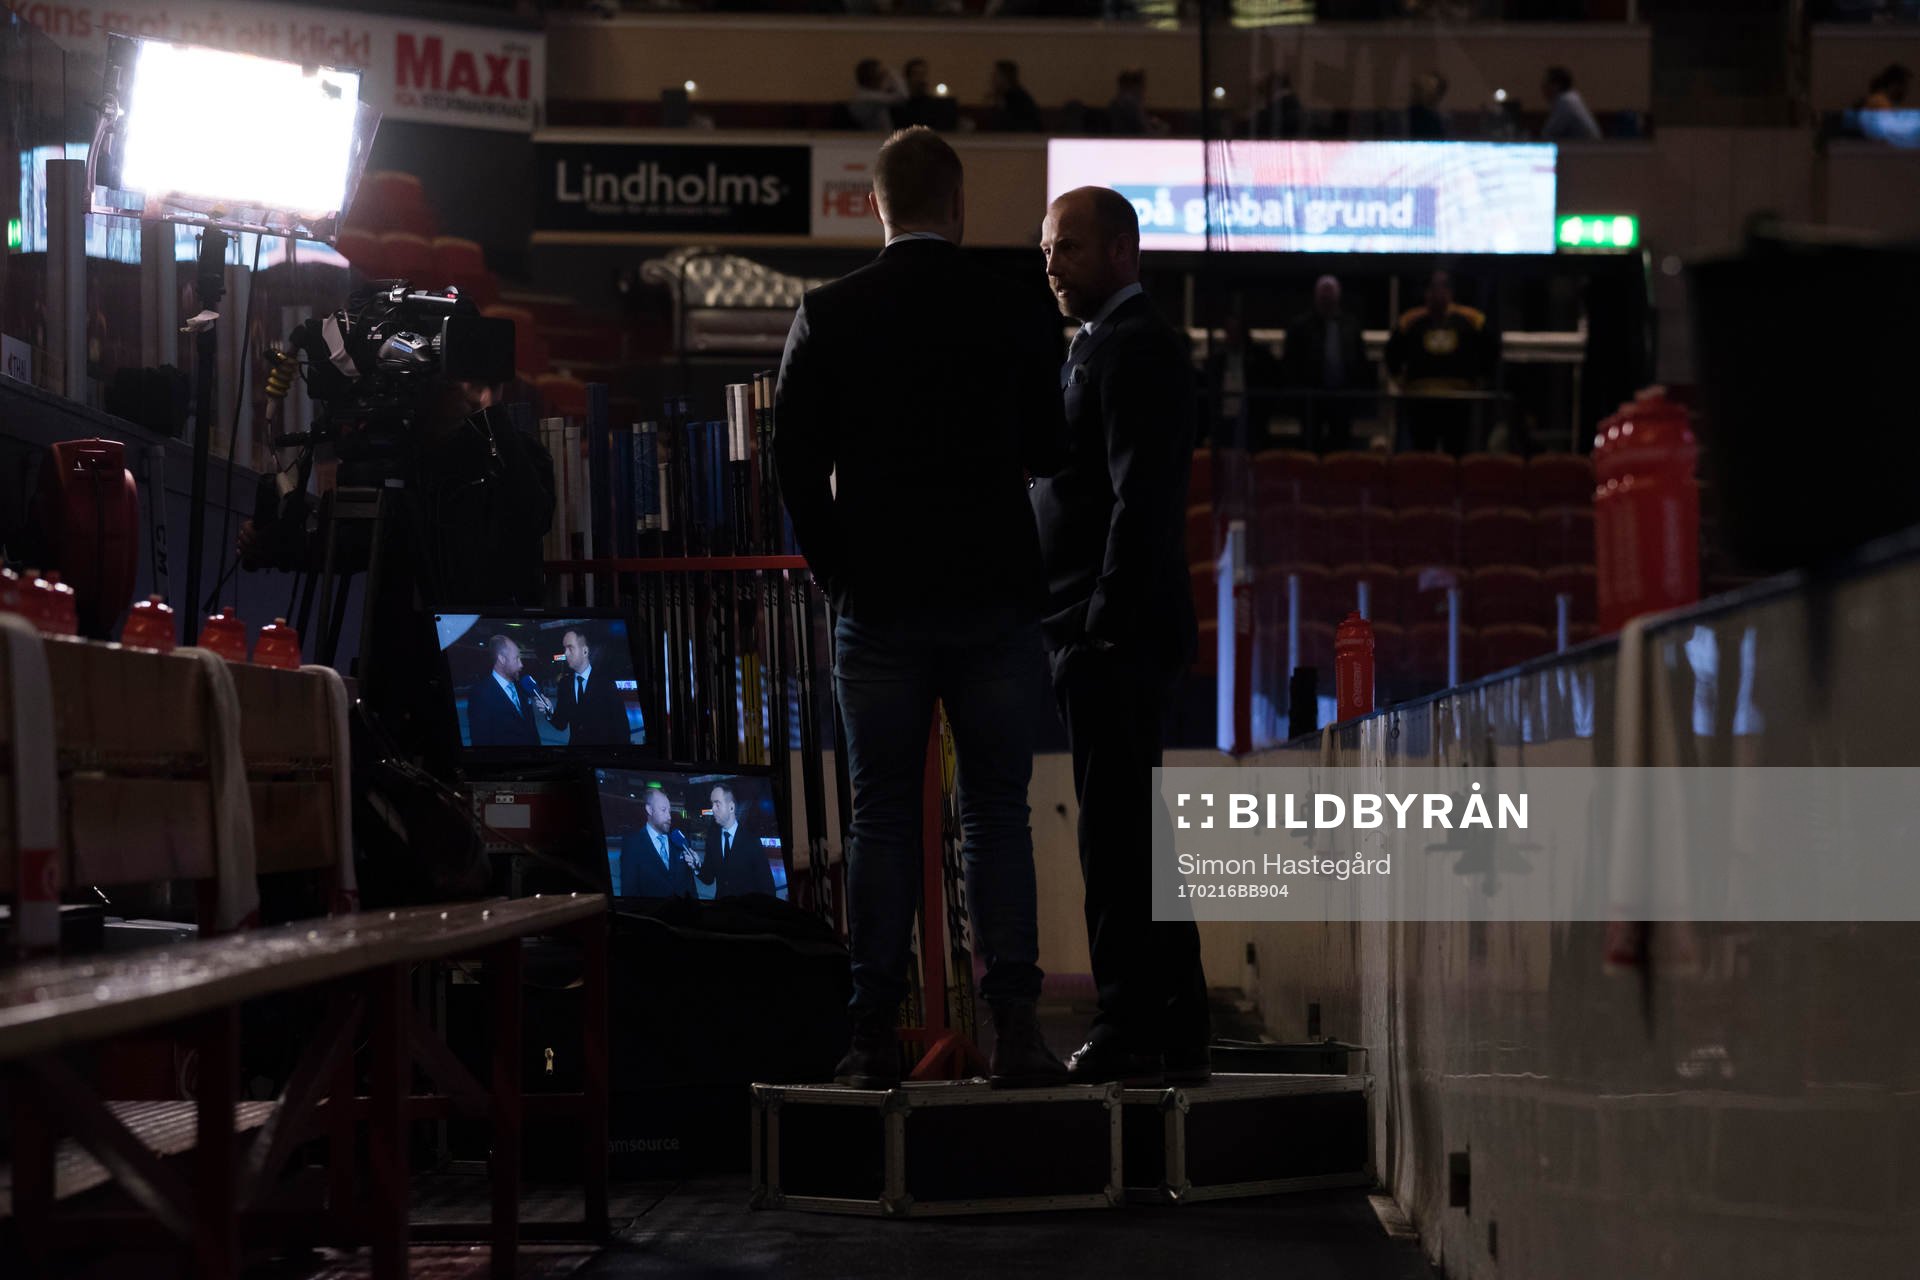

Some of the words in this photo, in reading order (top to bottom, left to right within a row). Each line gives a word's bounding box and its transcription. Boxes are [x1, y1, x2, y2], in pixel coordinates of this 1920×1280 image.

[396, 33, 529, 100] MAXI
[556, 158, 783, 206] Lindholms
[1184, 190, 1297, 234] global
[1303, 191, 1414, 234] grund
